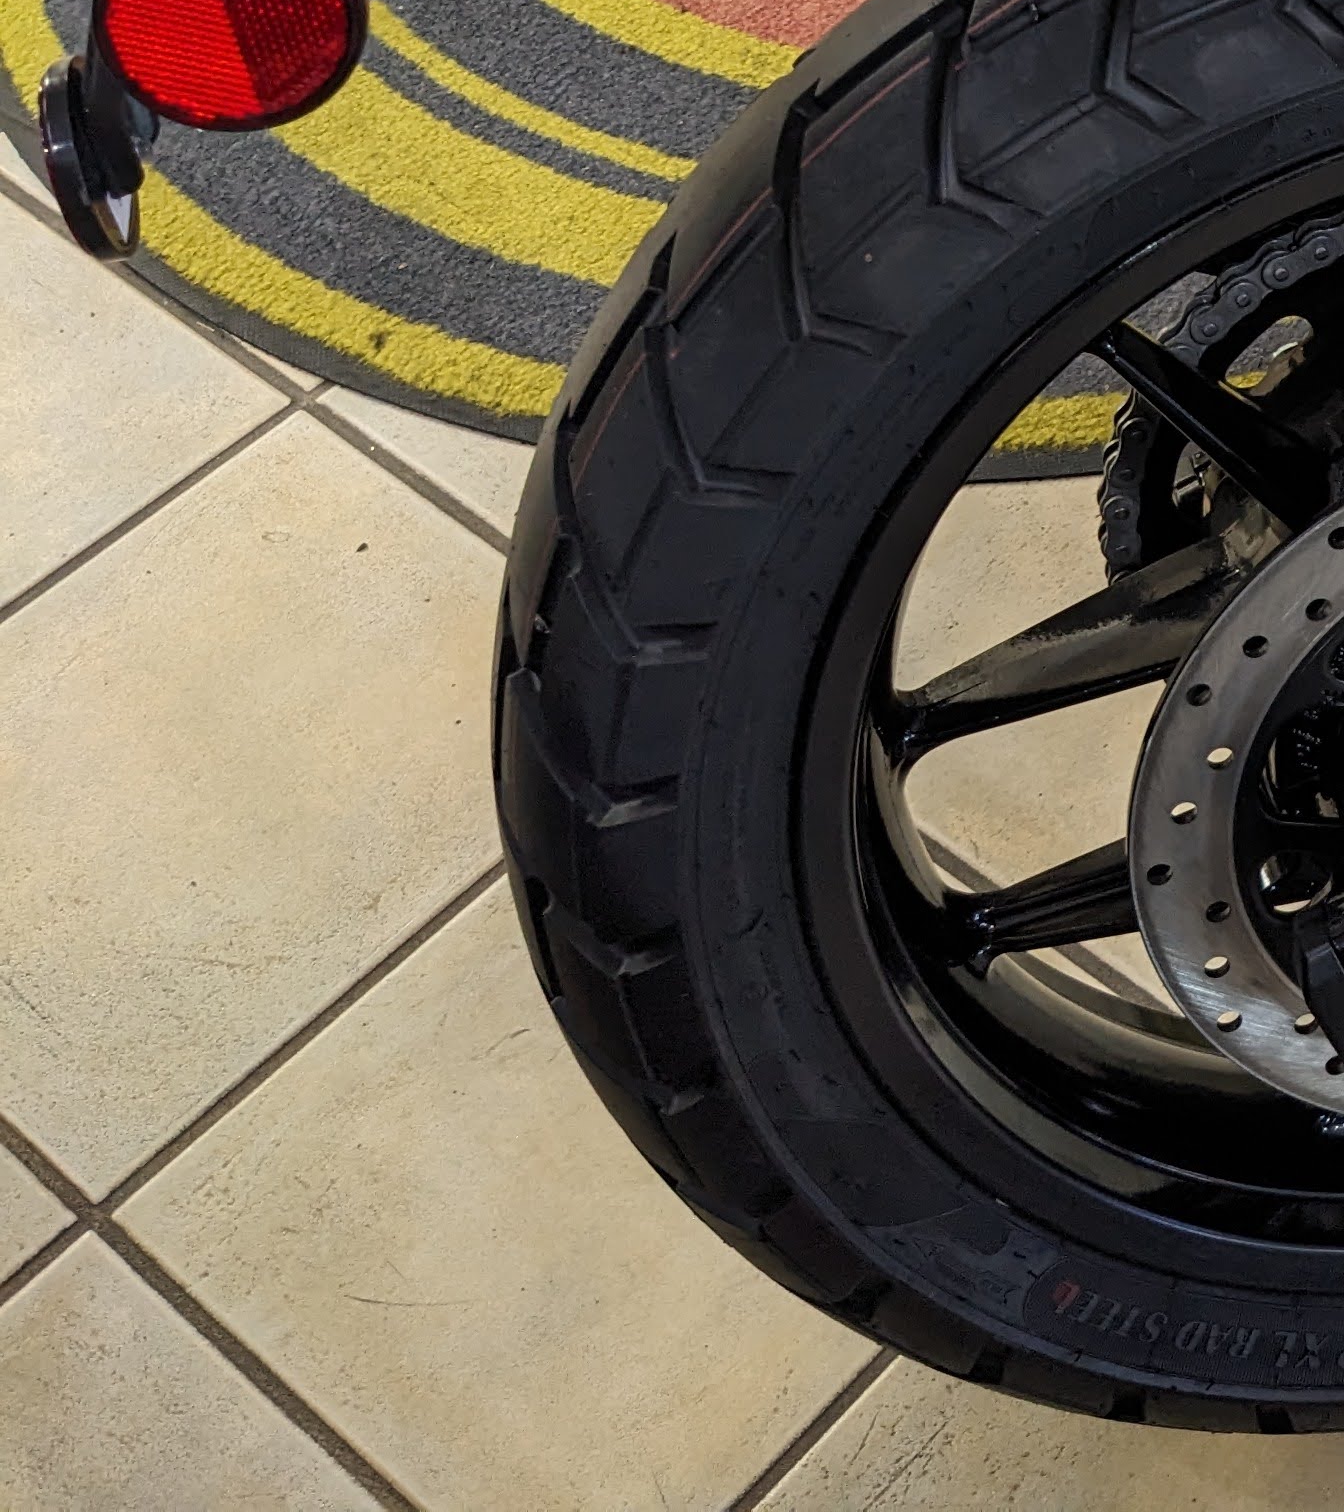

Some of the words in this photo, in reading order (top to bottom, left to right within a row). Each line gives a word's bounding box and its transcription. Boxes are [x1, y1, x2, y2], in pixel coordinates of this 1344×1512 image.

[1049, 1277, 1168, 1344] STEEL
[1171, 1319, 1262, 1359] RAD
[1272, 1328, 1328, 1368] XL
